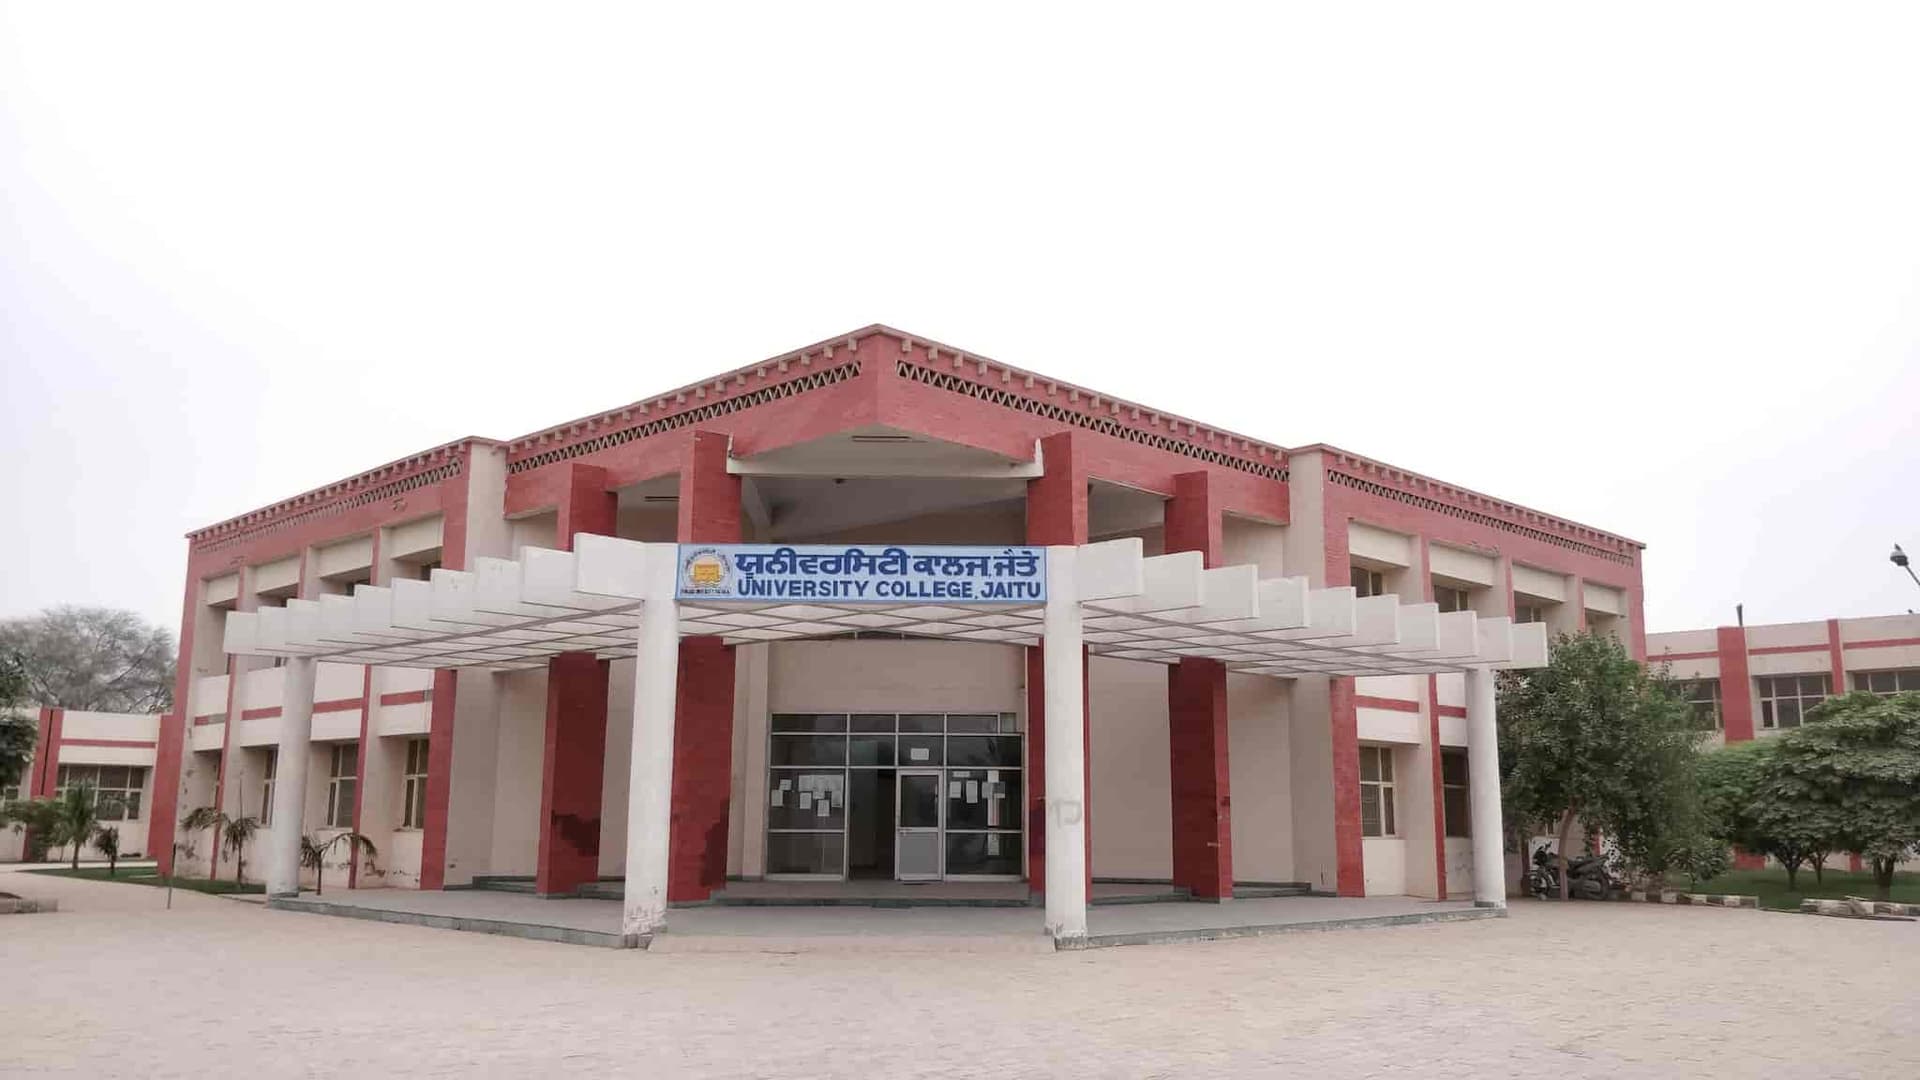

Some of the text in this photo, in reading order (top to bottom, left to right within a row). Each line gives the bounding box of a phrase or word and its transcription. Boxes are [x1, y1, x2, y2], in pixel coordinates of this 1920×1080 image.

[735, 547, 910, 579] ਯੂਨੀਵਰਸਿਟੀ
[738, 579, 869, 597] UNIVERSITY
[980, 581, 1041, 598] JAITU
